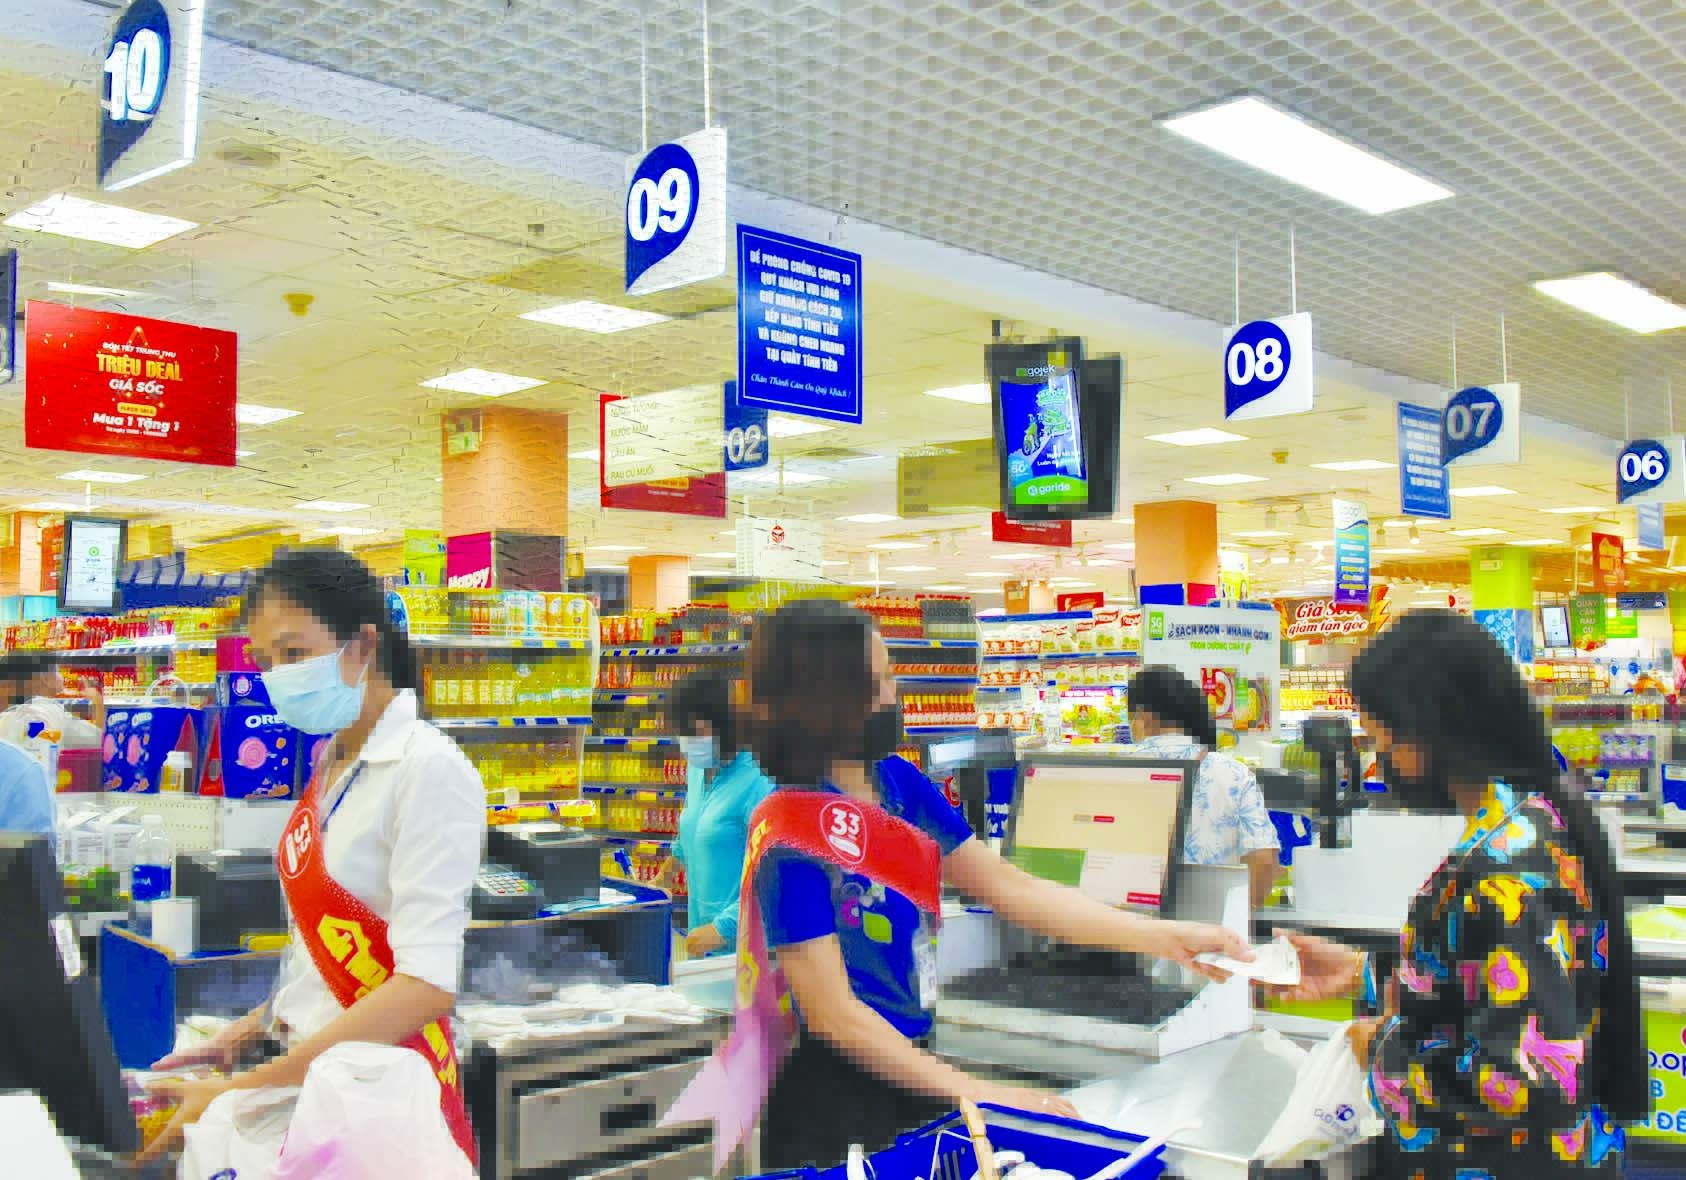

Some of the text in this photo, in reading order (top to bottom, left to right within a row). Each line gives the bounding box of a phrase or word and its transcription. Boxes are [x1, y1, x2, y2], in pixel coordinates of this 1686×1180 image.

[104, 28, 162, 120] 10
[628, 167, 692, 241] 09
[818, 267, 841, 283] COVID
[842, 273, 851, 286] 19
[96, 353, 183, 382] TRIỆU DEAL
[161, 349, 176, 359] THU
[1227, 337, 1284, 386] 08
[1027, 364, 1056, 377] gojek
[109, 378, 165, 395] GIÁ SỐC
[92, 412, 125, 426] Mua
[127, 415, 133, 427] 1
[136, 416, 169, 432] Tặng
[1447, 402, 1495, 440] 07
[727, 424, 763, 464] 02
[1620, 450, 1664, 482] 06
[245, 714, 284, 729] ORE
[832, 807, 860, 836] 33
